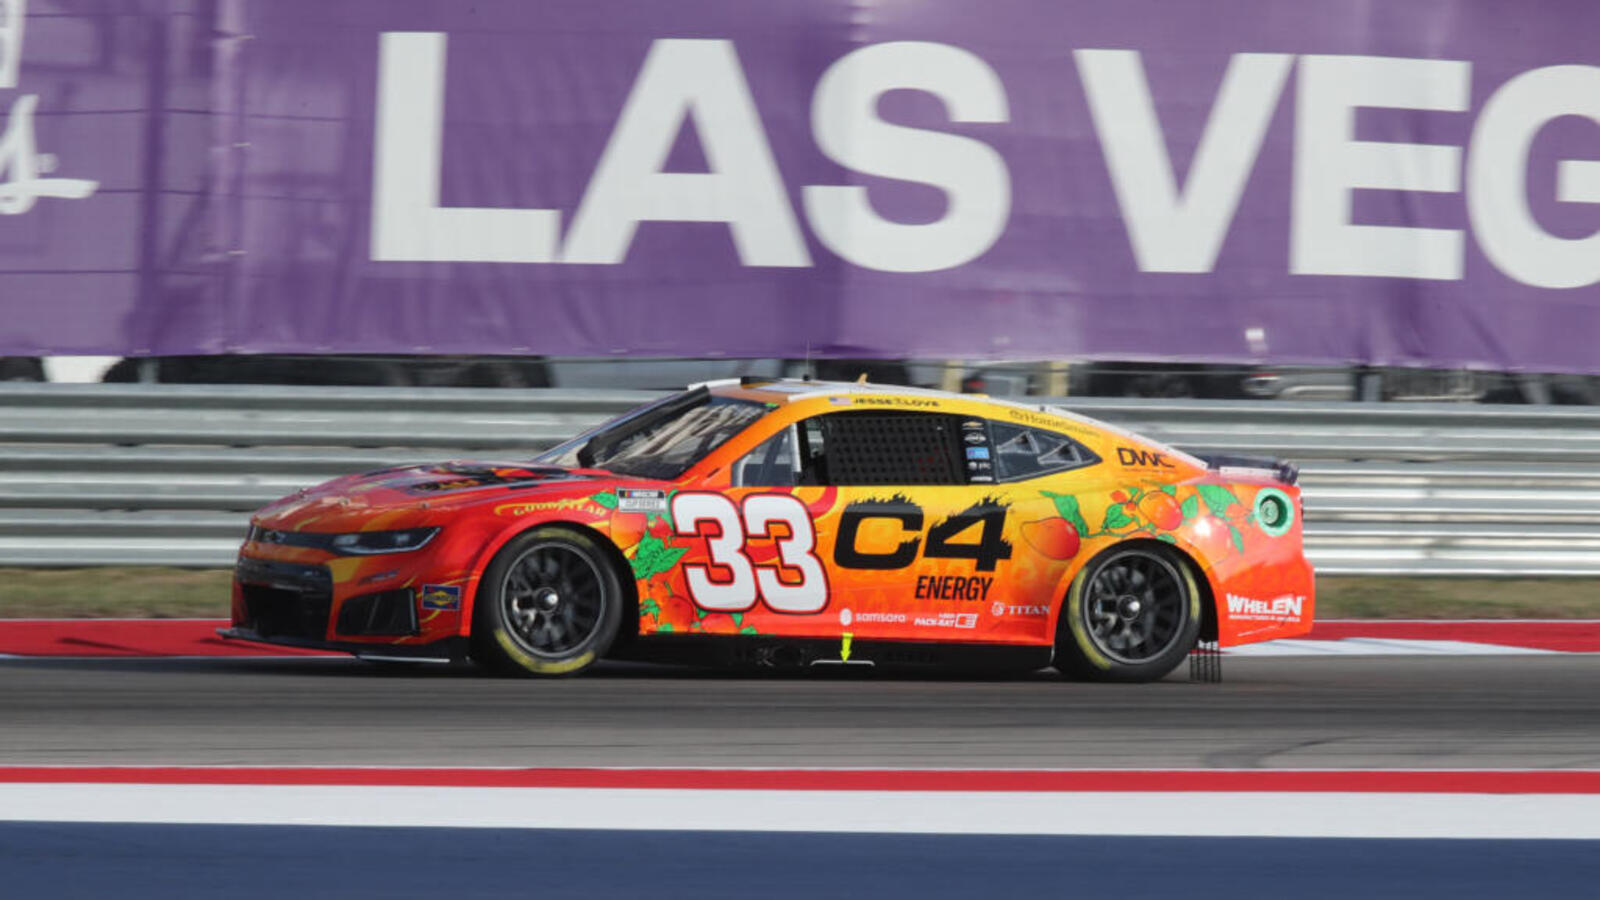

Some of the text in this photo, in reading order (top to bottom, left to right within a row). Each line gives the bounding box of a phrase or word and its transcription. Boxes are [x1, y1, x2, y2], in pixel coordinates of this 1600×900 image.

[370, 31, 1012, 273] LAS
[1073, 48, 1600, 290] VEG
[513, 499, 607, 517] GOODYEAR
[833, 492, 1013, 572] C4
[671, 490, 831, 615] 33
[914, 575, 994, 601] ENERGY
[1008, 604, 1050, 616] TITAN
[1226, 592, 1303, 616] WHELEN
[856, 612, 906, 623] samsara
